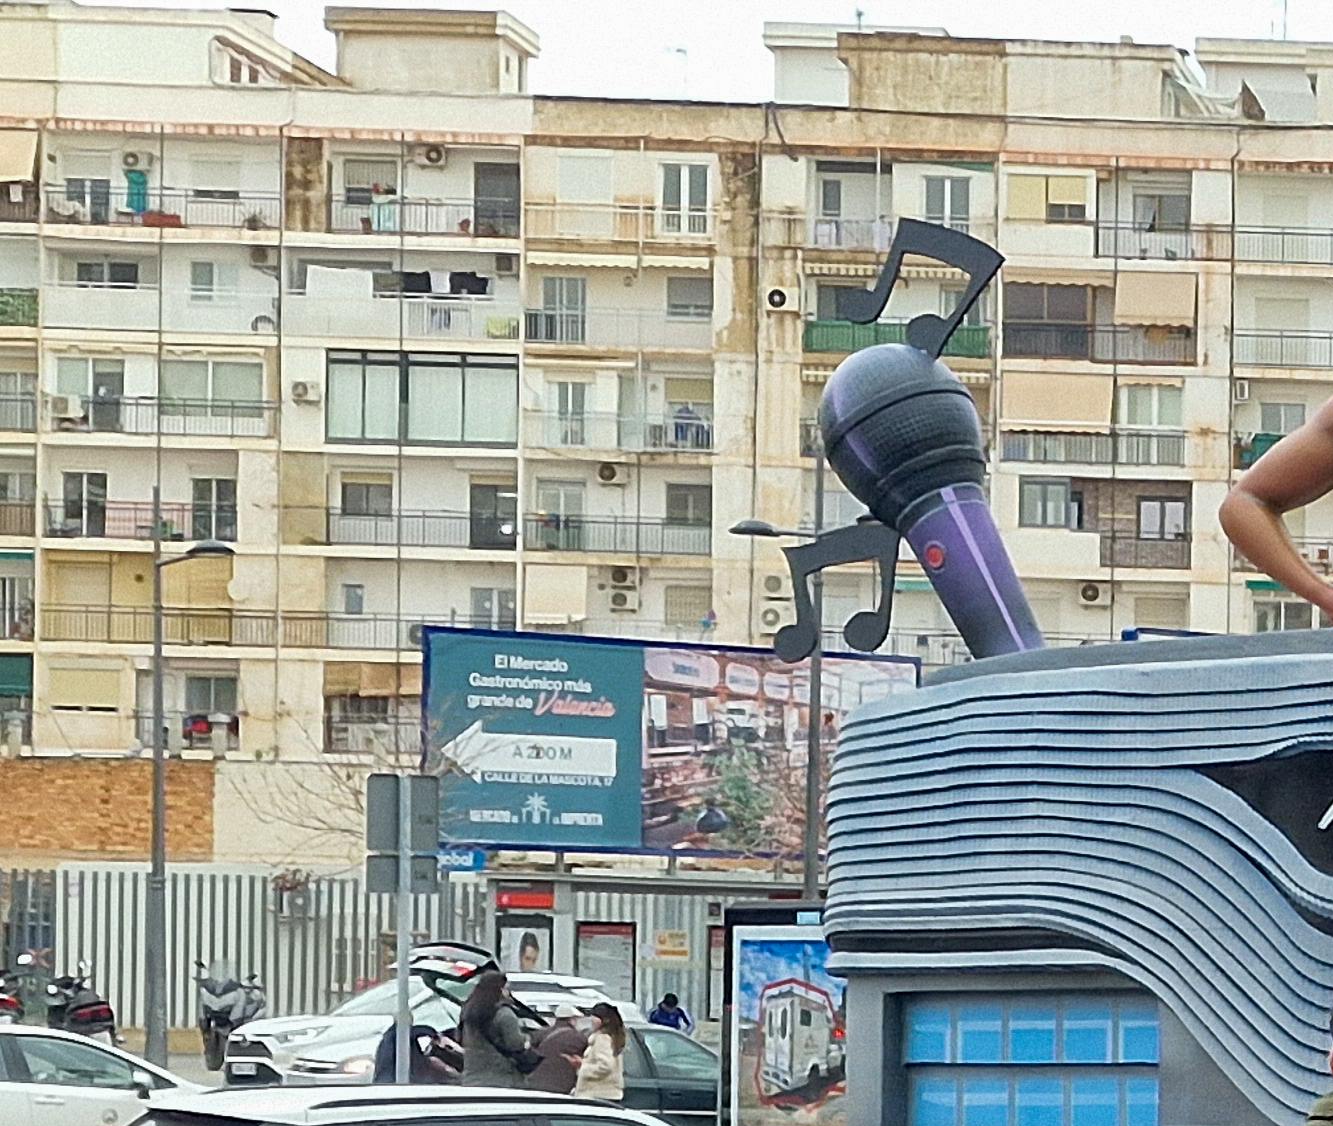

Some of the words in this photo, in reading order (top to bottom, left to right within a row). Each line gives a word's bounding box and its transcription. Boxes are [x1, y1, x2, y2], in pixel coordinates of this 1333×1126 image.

[494, 654, 508, 668] El
[510, 656, 568, 672] Mercado
[469, 672, 562, 692] Gastronómico
[564, 679, 592, 693] más
[467, 694, 514, 709] grande
[515, 695, 533, 709] de
[512, 746, 523, 758] A
[560, 747, 572, 760] M
[484, 772, 518, 783] CALLE
[519, 774, 534, 784] DE
[535, 774, 550, 784] LA
